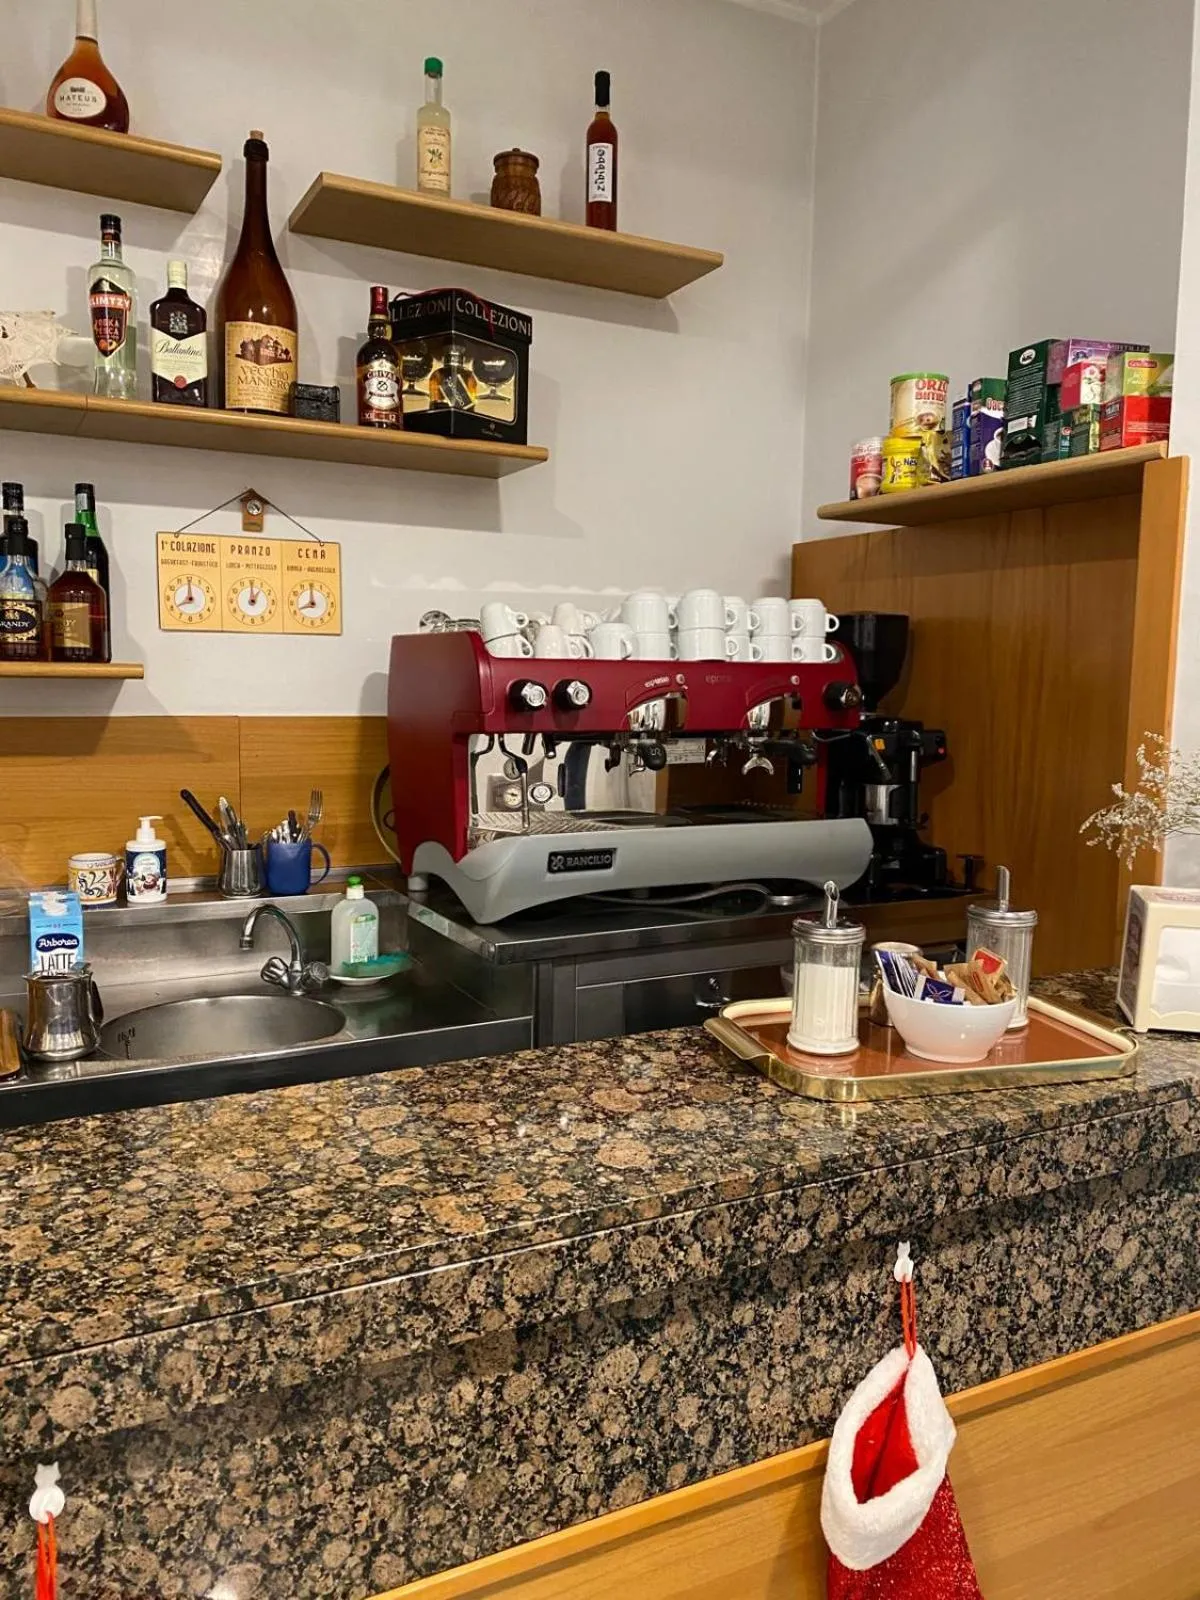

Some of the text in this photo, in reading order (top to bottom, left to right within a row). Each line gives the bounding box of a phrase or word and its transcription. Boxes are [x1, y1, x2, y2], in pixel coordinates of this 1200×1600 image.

[455, 297, 532, 337] COLLEZIONI
[170, 541, 216, 554] COLAZIONE
[230, 544, 271, 557] PRANZO
[297, 547, 326, 560] CENA
[0, 621, 30, 629] RANDY
[566, 854, 612, 867] RANCILIO
[38, 937, 78, 948] Arborea
[40, 952, 75, 972] LATTE
